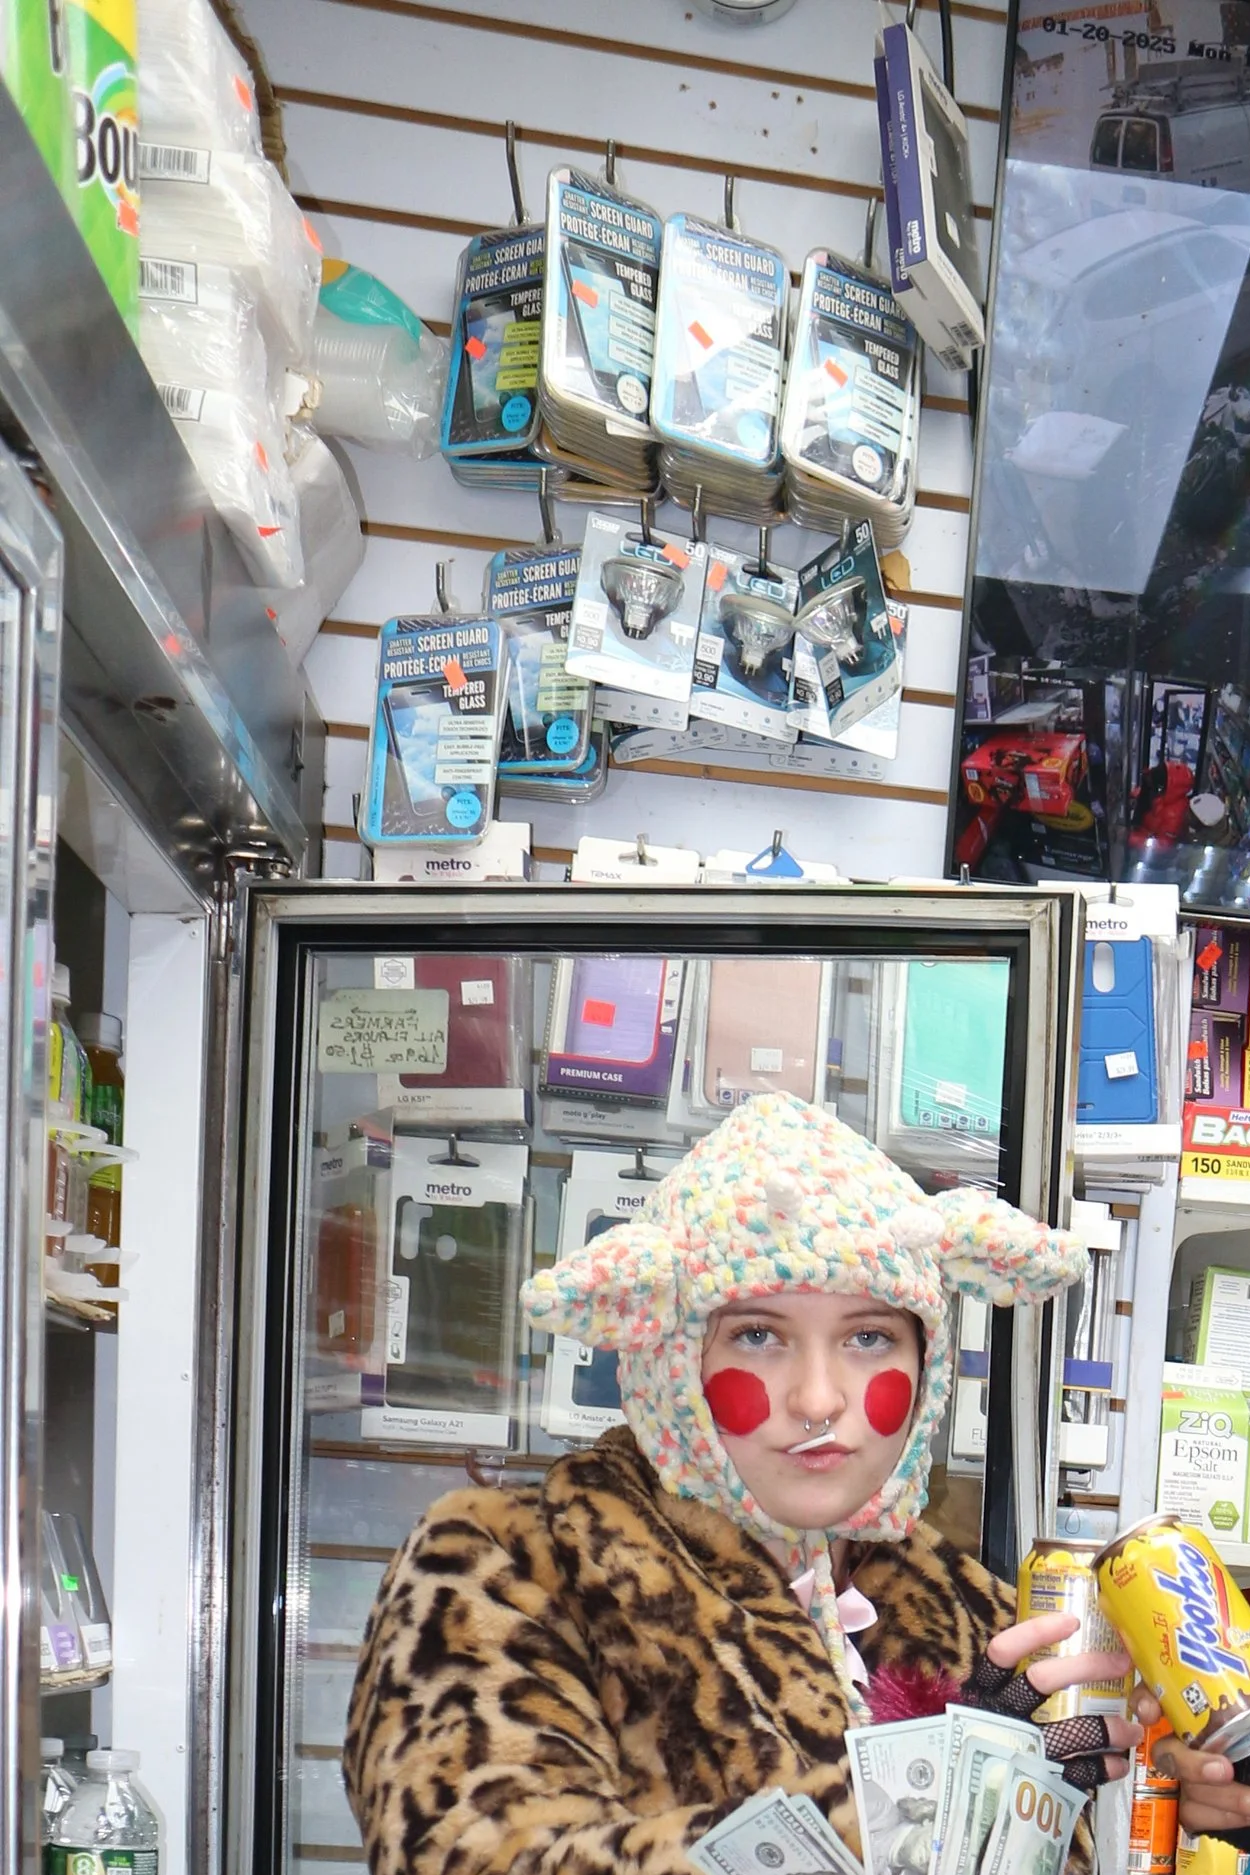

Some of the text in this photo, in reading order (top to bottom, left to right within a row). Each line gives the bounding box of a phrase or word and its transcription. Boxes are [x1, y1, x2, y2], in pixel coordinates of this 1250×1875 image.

[1042, 17, 1175, 54] 01-20-2025
[1188, 40, 1232, 62] Mon
[590, 201, 654, 239] SCREEN GUARD
[911, 219, 921, 254] metro
[494, 242, 524, 265] SCREEN
[705, 244, 775, 277] SCREEN GUARD
[615, 262, 652, 287] TEMPERED
[630, 281, 653, 303] GLASS
[844, 282, 878, 308] SCREEN
[864, 339, 900, 366] TEMPERED
[877, 358, 900, 379] GLASS
[855, 523, 869, 544] 50
[620, 540, 673, 566] LED
[685, 541, 706, 559] 50
[522, 564, 556, 583] SCREEN
[820, 556, 855, 591] LED
[492, 583, 562, 610] PROTÈGE-ÉCRAN
[736, 572, 786, 600] LED
[887, 603, 907, 618] 50
[389, 638, 413, 649] SHATTER
[417, 627, 489, 651] SCREEN GUARD
[387, 646, 415, 656] RESISTANT
[462, 649, 490, 661] RESISTANT
[700, 644, 717, 656] 500
[462, 656, 492, 667] AUX CHOCS
[459, 696, 486, 711] GLASS
[426, 858, 472, 871] metro
[1085, 916, 1128, 930] metro
[560, 1067, 624, 1083] PREMIUM CASE
[563, 1109, 582, 1117] moto
[320, 1158, 343, 1172] metro
[1191, 1158, 1221, 1174] 150
[426, 1183, 472, 1197] metro
[382, 1414, 464, 1428] Samsung Galaxy A21
[1178, 1410, 1235, 1440] ZiQ
[1173, 1438, 1238, 1463] Epsom
[1193, 1439, 1222, 1447] NATURAL
[1194, 1459, 1217, 1473] Salt
[1014, 1780, 1063, 1840] 100
